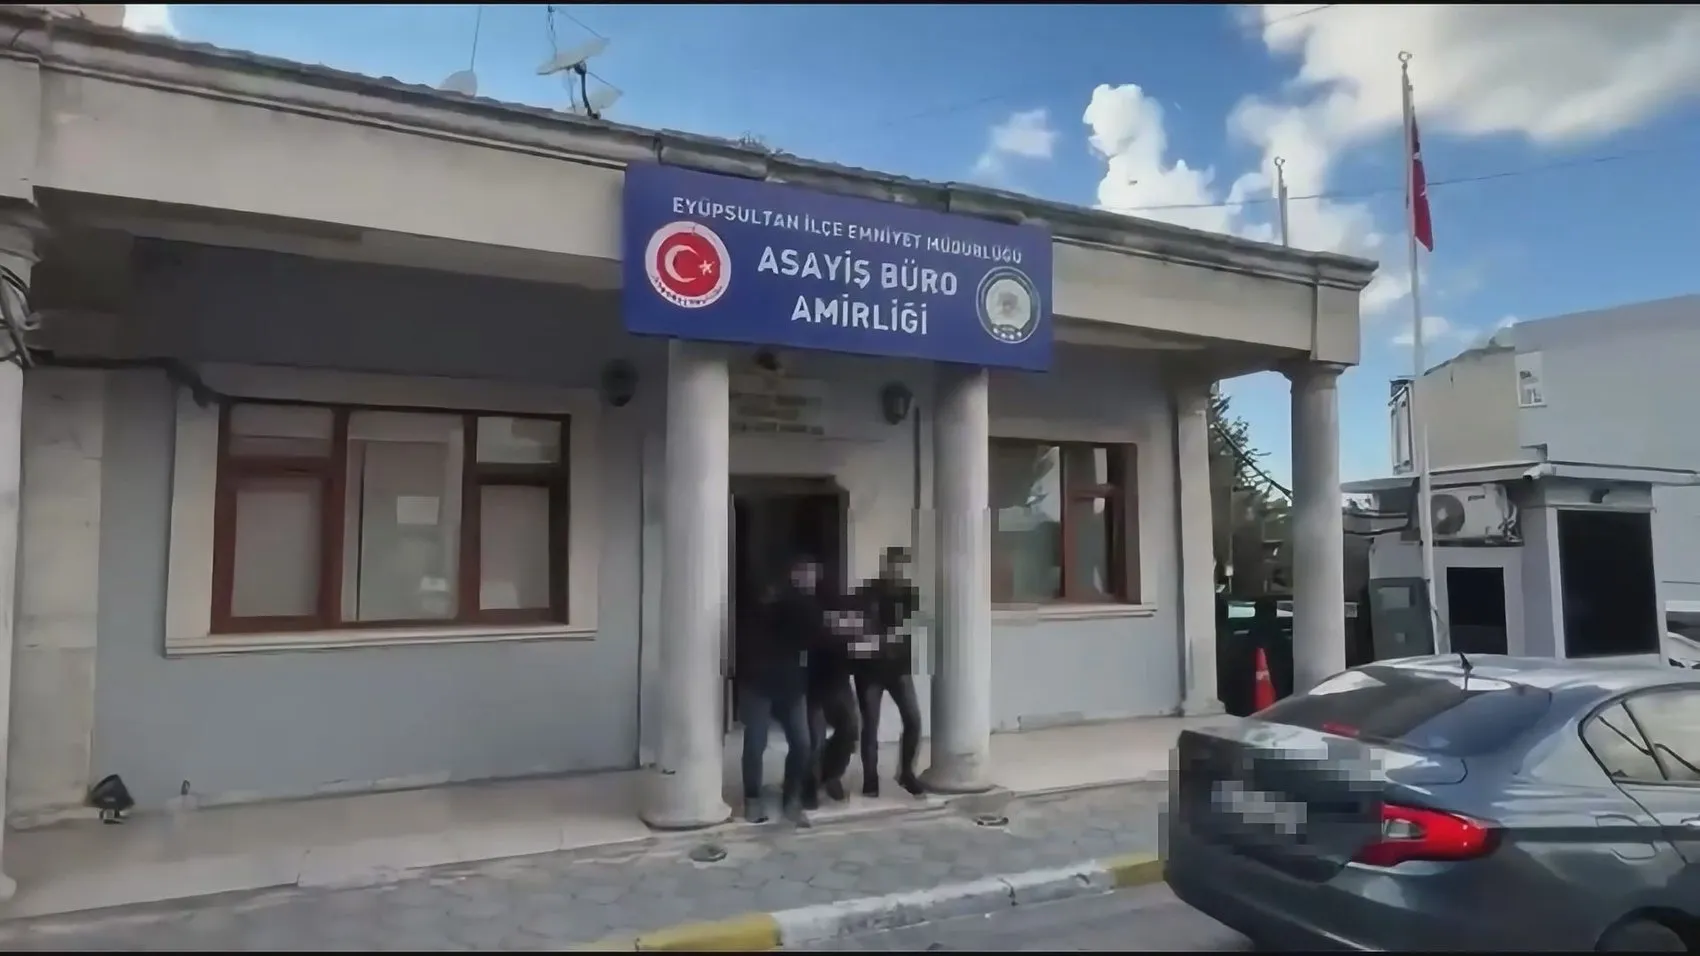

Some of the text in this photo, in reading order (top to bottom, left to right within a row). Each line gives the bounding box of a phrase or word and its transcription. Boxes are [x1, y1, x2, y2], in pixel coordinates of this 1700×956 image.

[672, 196, 799, 231] EYÜPSULTAN
[804, 213, 843, 238] İLÇE
[848, 224, 922, 249] EMNİYET
[757, 246, 958, 296] ASAYİŞ BÜRO
[791, 294, 928, 335] AMİRLİĞİ
